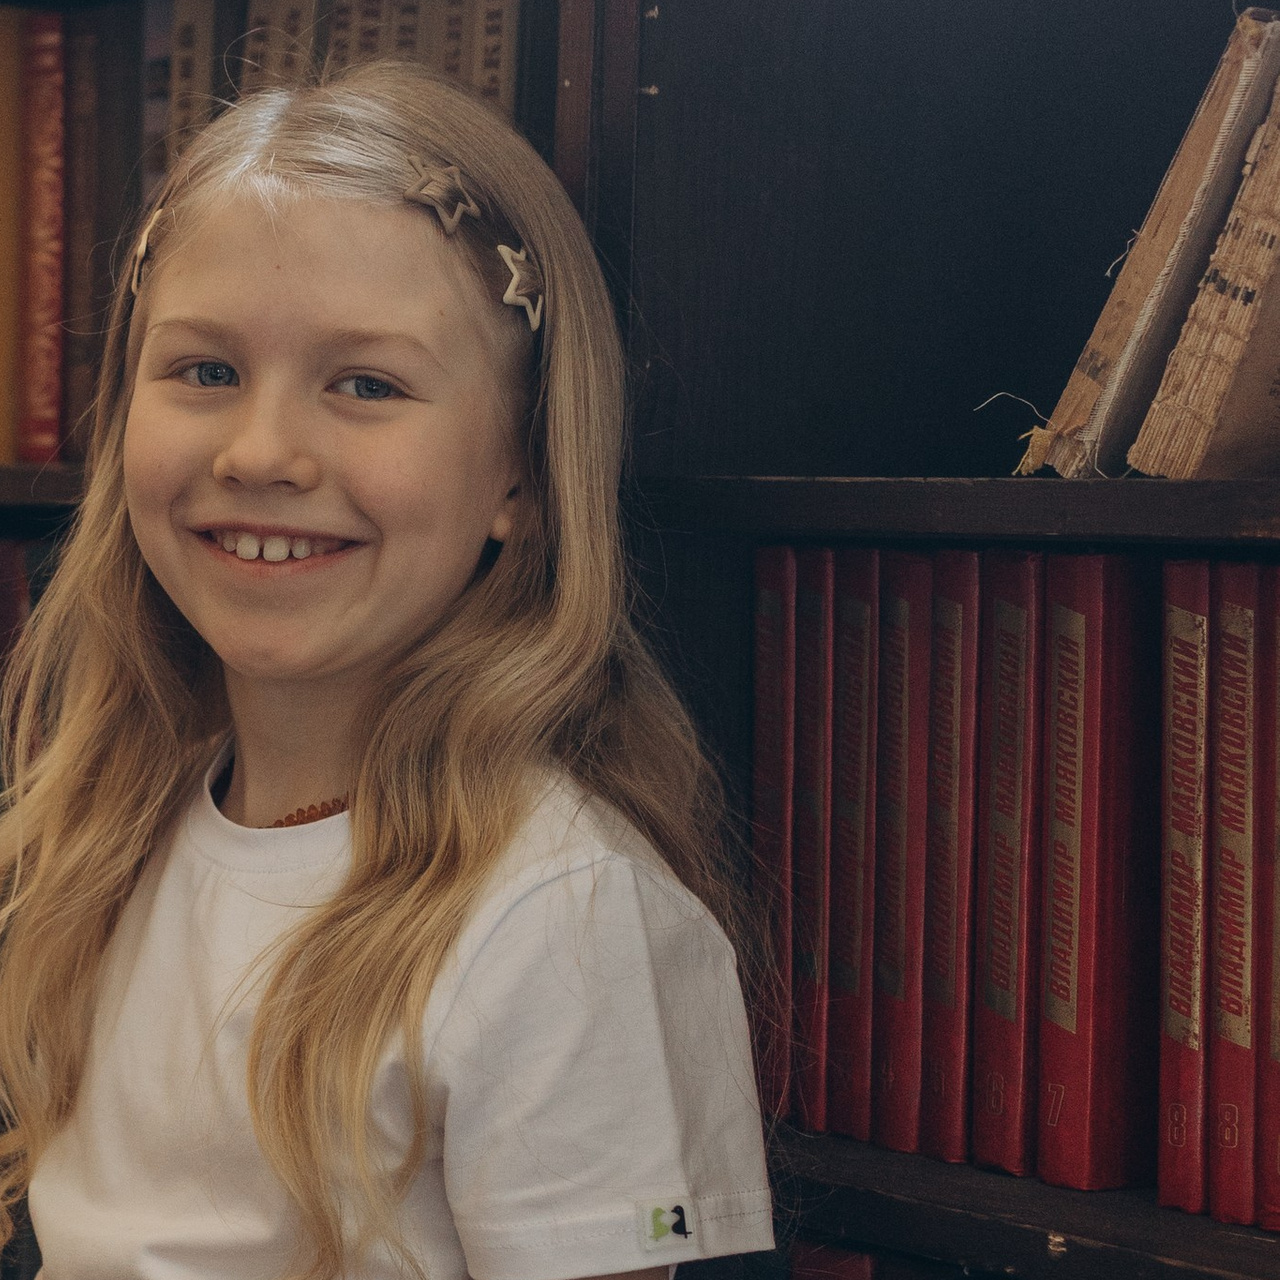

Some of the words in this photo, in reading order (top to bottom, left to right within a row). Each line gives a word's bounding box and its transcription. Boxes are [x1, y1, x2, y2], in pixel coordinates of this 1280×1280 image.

[934, 625, 960, 811] МАЯКОВСКИЙ
[992, 631, 1024, 820] МАЯКОВСКИЙ
[1051, 634, 1081, 828] МАЯКОВСКИЙ
[1168, 638, 1200, 838] МАЯКОВСКИЙ
[1216, 632, 1249, 834] МАЯКОВСКИЙ
[931, 825, 954, 980] ВЛАДИМИР
[989, 834, 1015, 992] ВЛАДИМИР
[1048, 842, 1076, 1003] ВЛАДИМИР
[1166, 852, 1196, 1018] ВЛАДИМИР
[1216, 847, 1246, 1018] ВЛАДИМИР
[985, 1071, 1005, 1116] 6
[1046, 1082, 1066, 1128] 7
[1167, 1103, 1188, 1148] 8
[1217, 1103, 1240, 1149] 8
